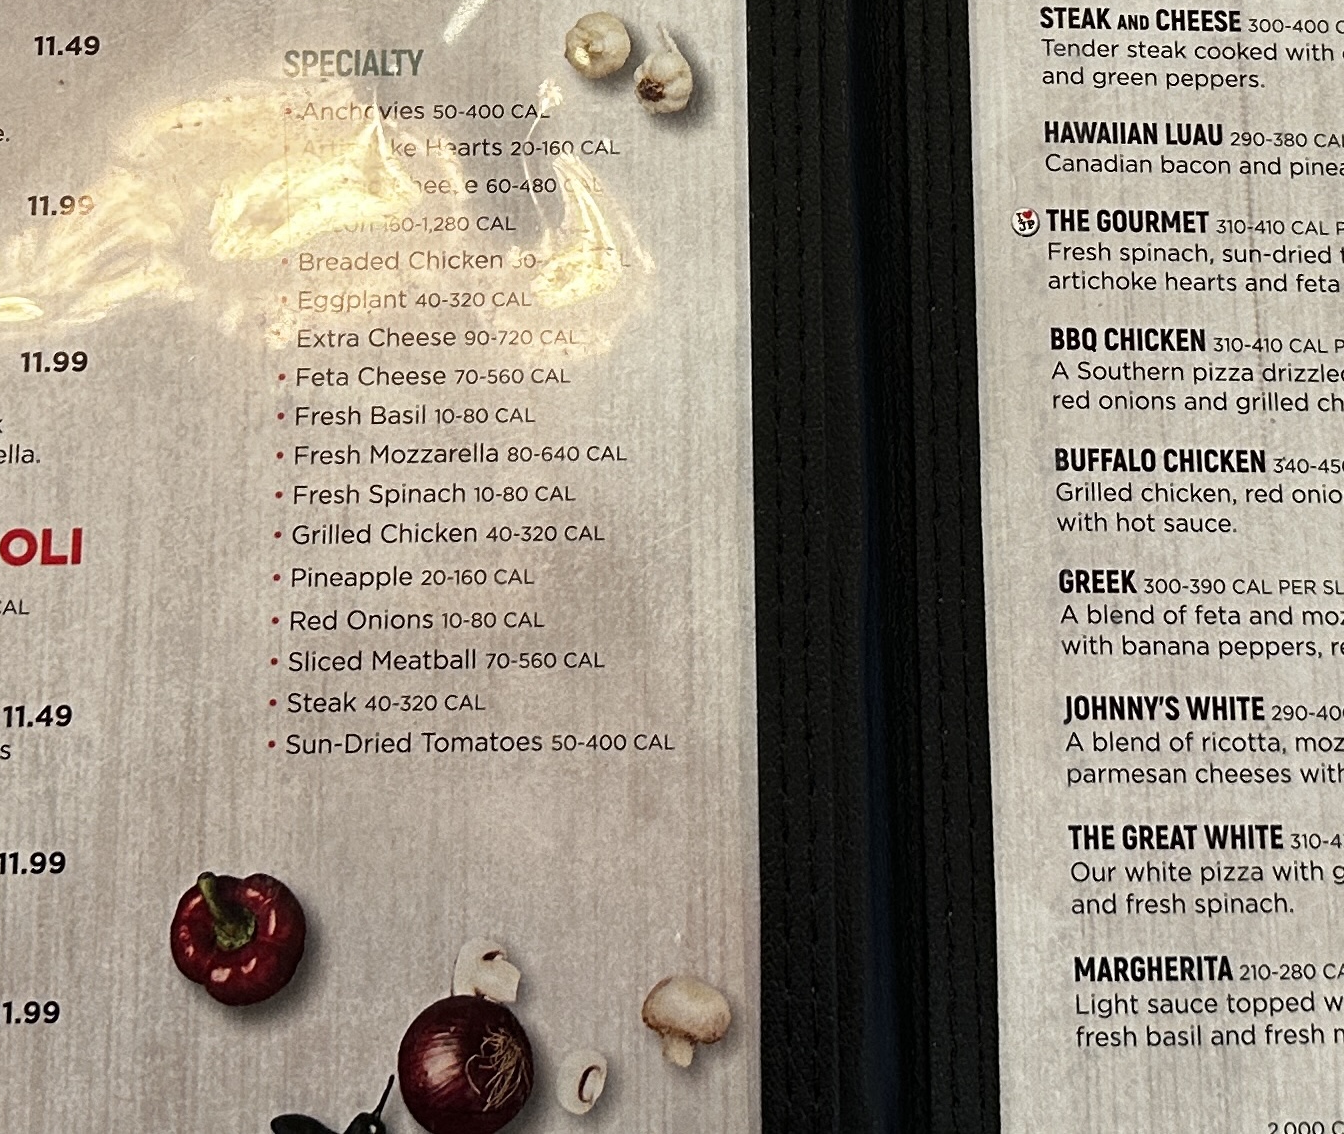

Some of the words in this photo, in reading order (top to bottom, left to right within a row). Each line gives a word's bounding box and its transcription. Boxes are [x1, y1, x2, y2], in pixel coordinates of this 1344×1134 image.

[35, 36, 99, 55] 11.49
[284, 49, 424, 78] SPECIALTY
[298, 292, 407, 313] Eggplant
[416, 293, 484, 307] 40-320
[492, 292, 530, 306] CAL
[1059, 569, 1137, 593] GREEK
[1144, 579, 1225, 594] 300-390
[1233, 579, 1272, 594] CAL
[1279, 580, 1316, 594] PER
[286, 732, 411, 754] Sun-Dried
[421, 732, 542, 752] Tomatoes
[552, 734, 626, 751] 50-400
[634, 734, 675, 750] CAL
[1075, 956, 1233, 982] MARGHERITA
[1240, 964, 1316, 980] 210-280
